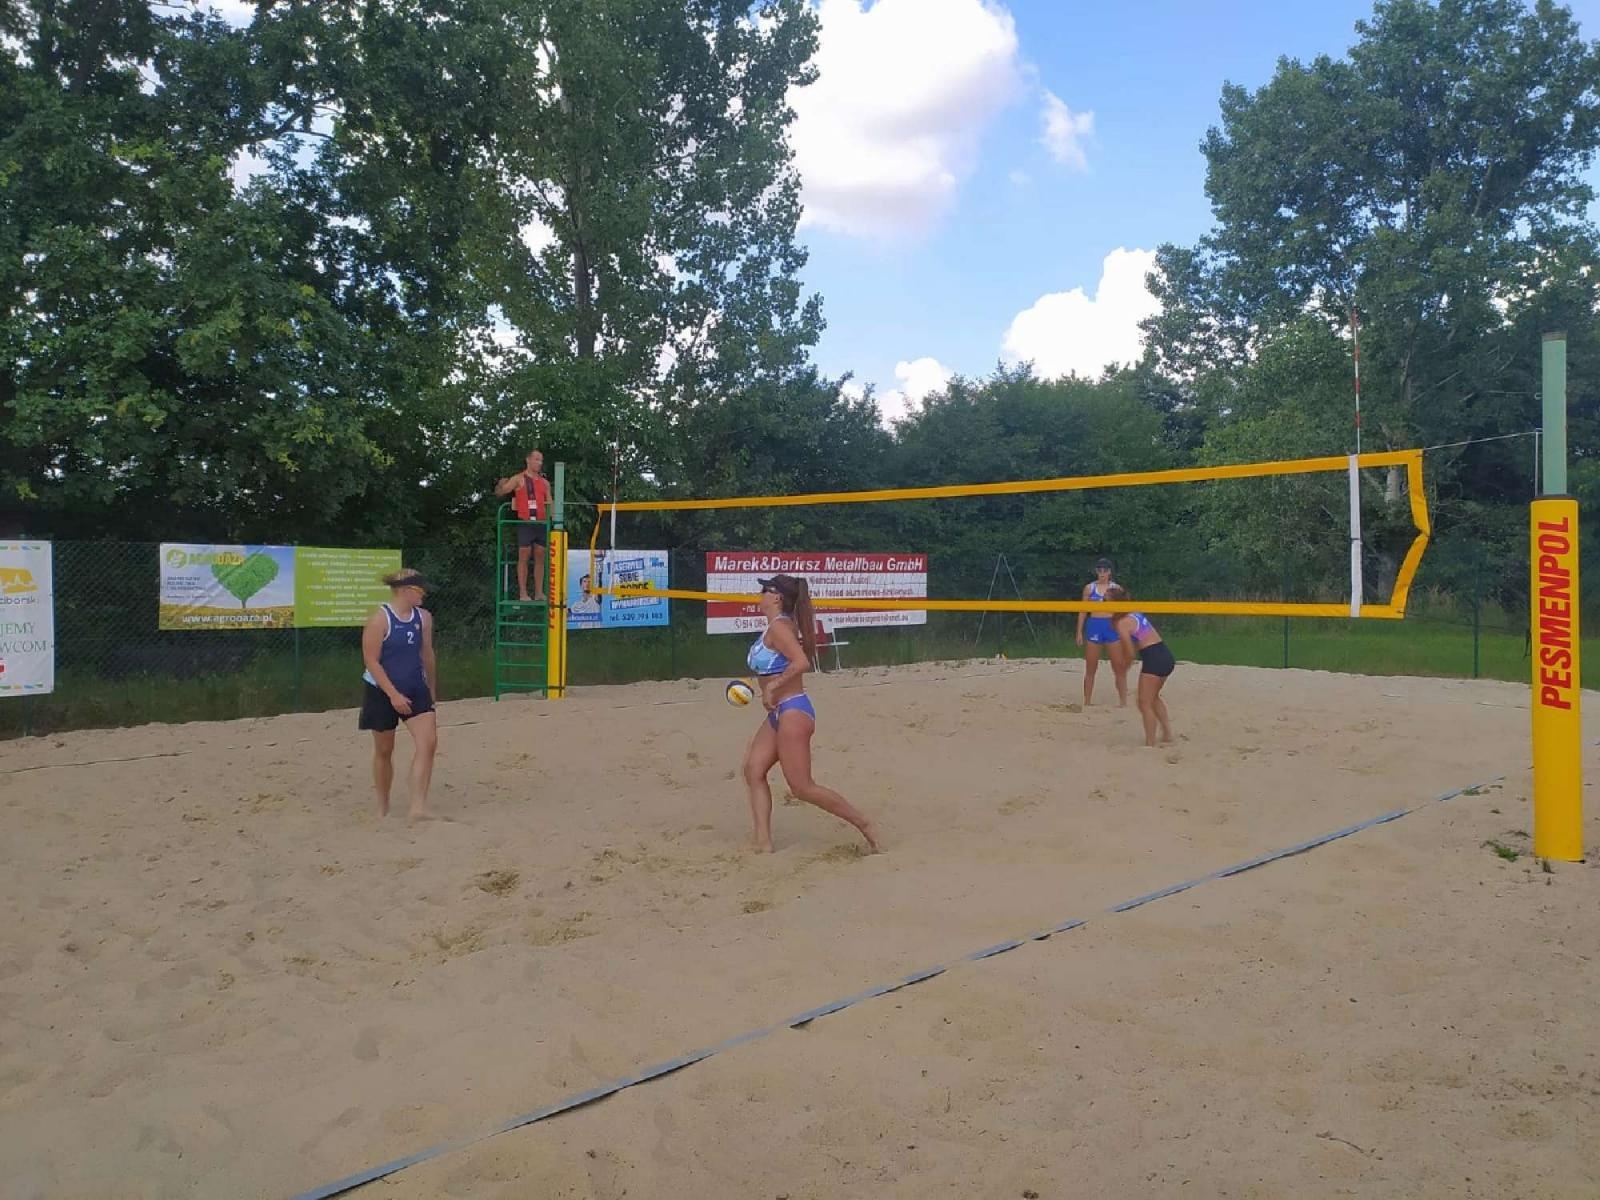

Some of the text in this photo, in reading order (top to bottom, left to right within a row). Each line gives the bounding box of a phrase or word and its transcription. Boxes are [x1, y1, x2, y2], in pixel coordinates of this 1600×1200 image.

[824, 557, 883, 571] Metallbau
[887, 558, 923, 571] GmbH
[1537, 516, 1572, 710] PESMENPOL
[407, 631, 415, 645] 2
